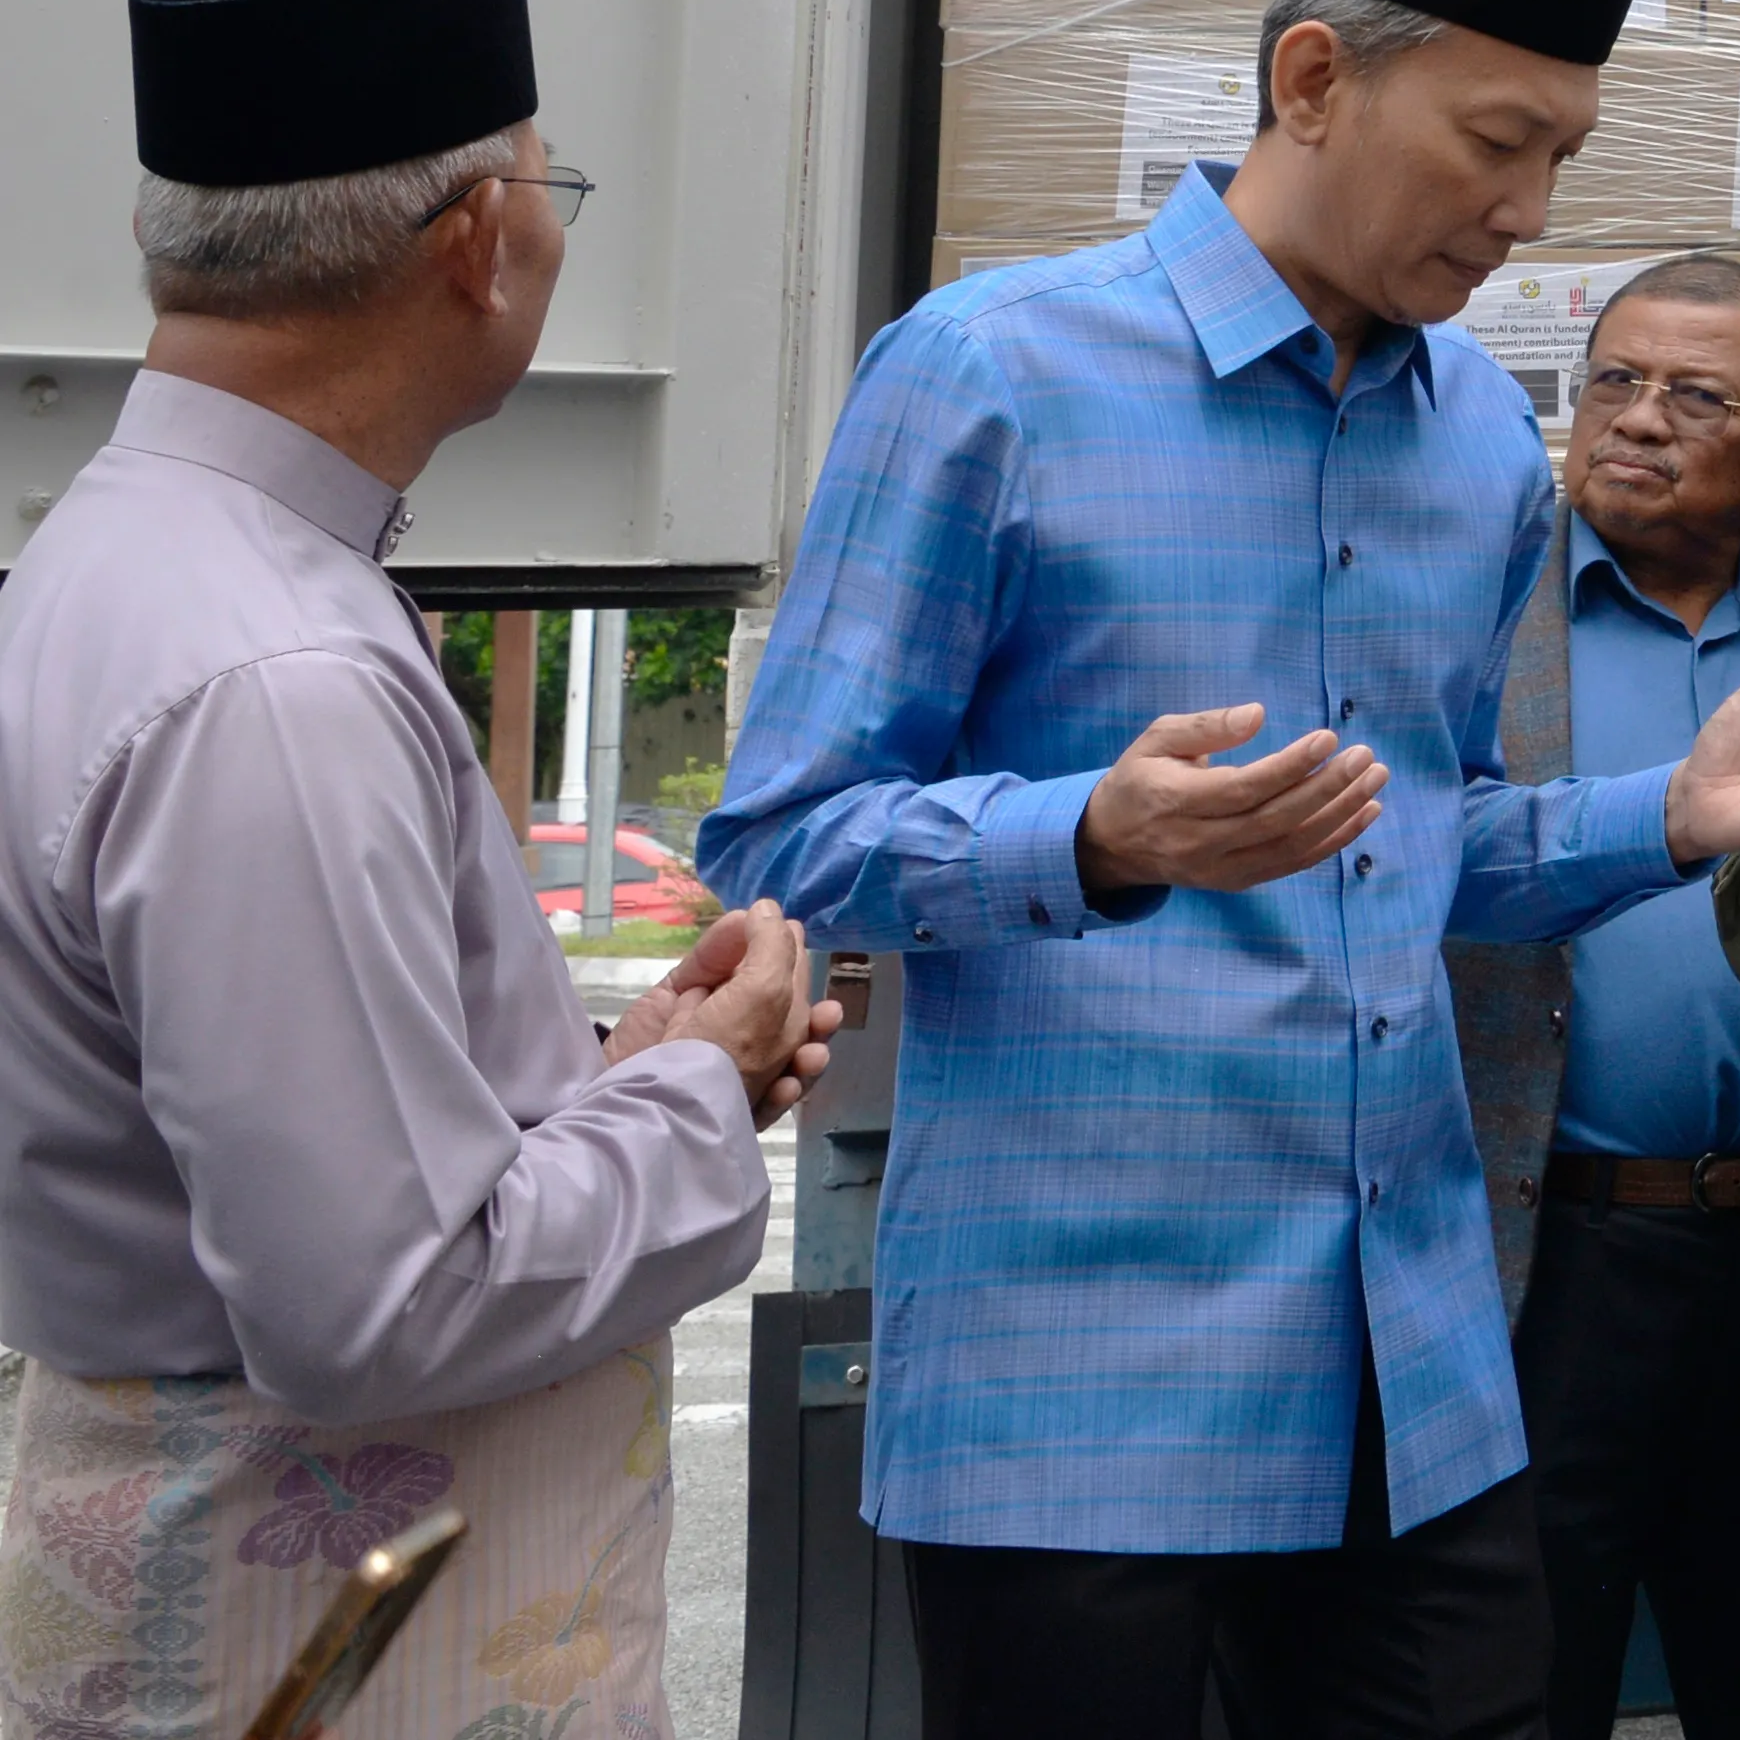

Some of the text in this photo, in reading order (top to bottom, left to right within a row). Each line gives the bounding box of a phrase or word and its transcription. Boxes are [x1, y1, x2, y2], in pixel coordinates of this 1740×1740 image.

[1465, 324, 1591, 334] These Al Quran is funded
[1523, 337, 1587, 346] contribution
[1493, 351, 1551, 360] Foundation
[1554, 351, 1573, 360] and
